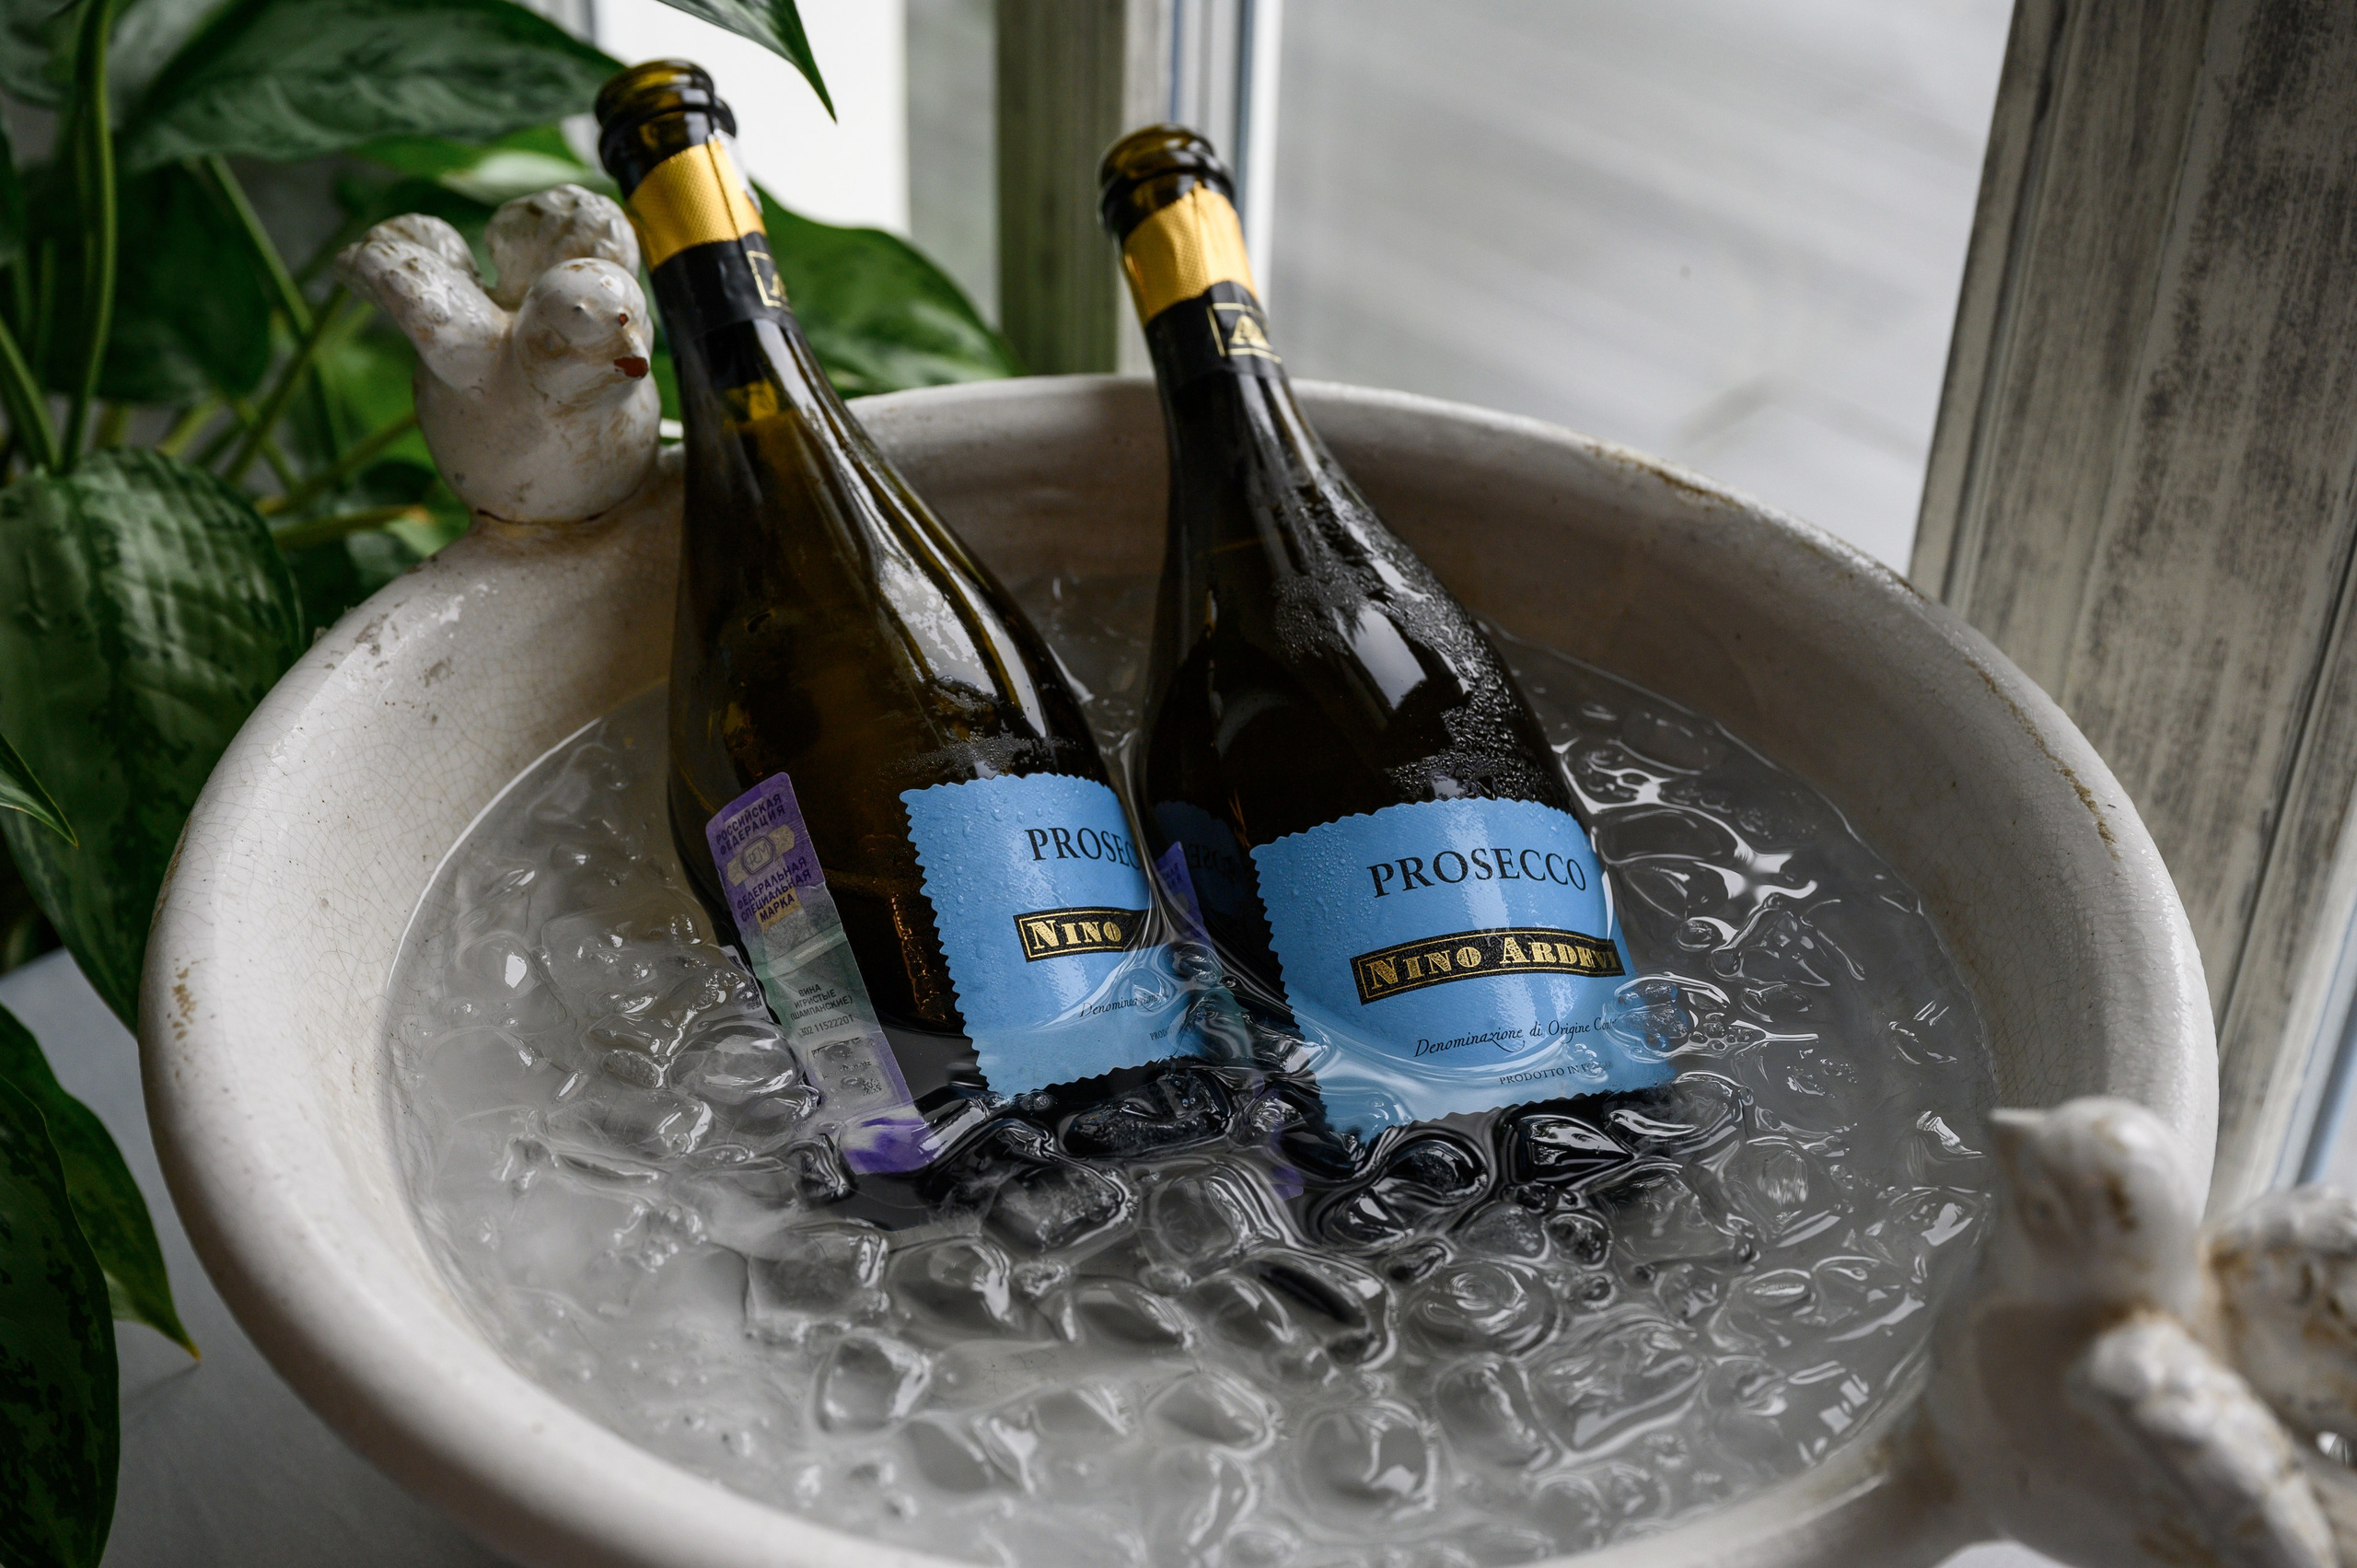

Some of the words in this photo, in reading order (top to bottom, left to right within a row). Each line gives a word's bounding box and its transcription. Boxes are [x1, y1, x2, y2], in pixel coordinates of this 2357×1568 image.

[716, 794, 782, 844] РОССИЙСКАЯ
[720, 805, 785, 855] ФЕДЕРАЦИЯ
[737, 857, 807, 911] ФЕДЕРАЛЬНАЯ
[1366, 847, 1586, 898] PROSECCO
[740, 869, 811, 923] СПЕЦИАЛЬНАЯ
[760, 893, 795, 923] МАРКА
[1027, 920, 1121, 949] NINO
[1364, 947, 1482, 990] NINO
[790, 994, 853, 1022] (ШАМПАНСКИЕ)
[794, 989, 837, 1009] ИГРИСТЫЕ
[798, 983, 821, 997] ВИНА
[1413, 1027, 1525, 1057] Denominazione
[1529, 1020, 1543, 1037] di
[1548, 1019, 1591, 1044] Origine
[1499, 1067, 1564, 1085] PRODOTTO
[1568, 1064, 1579, 1074] IN
